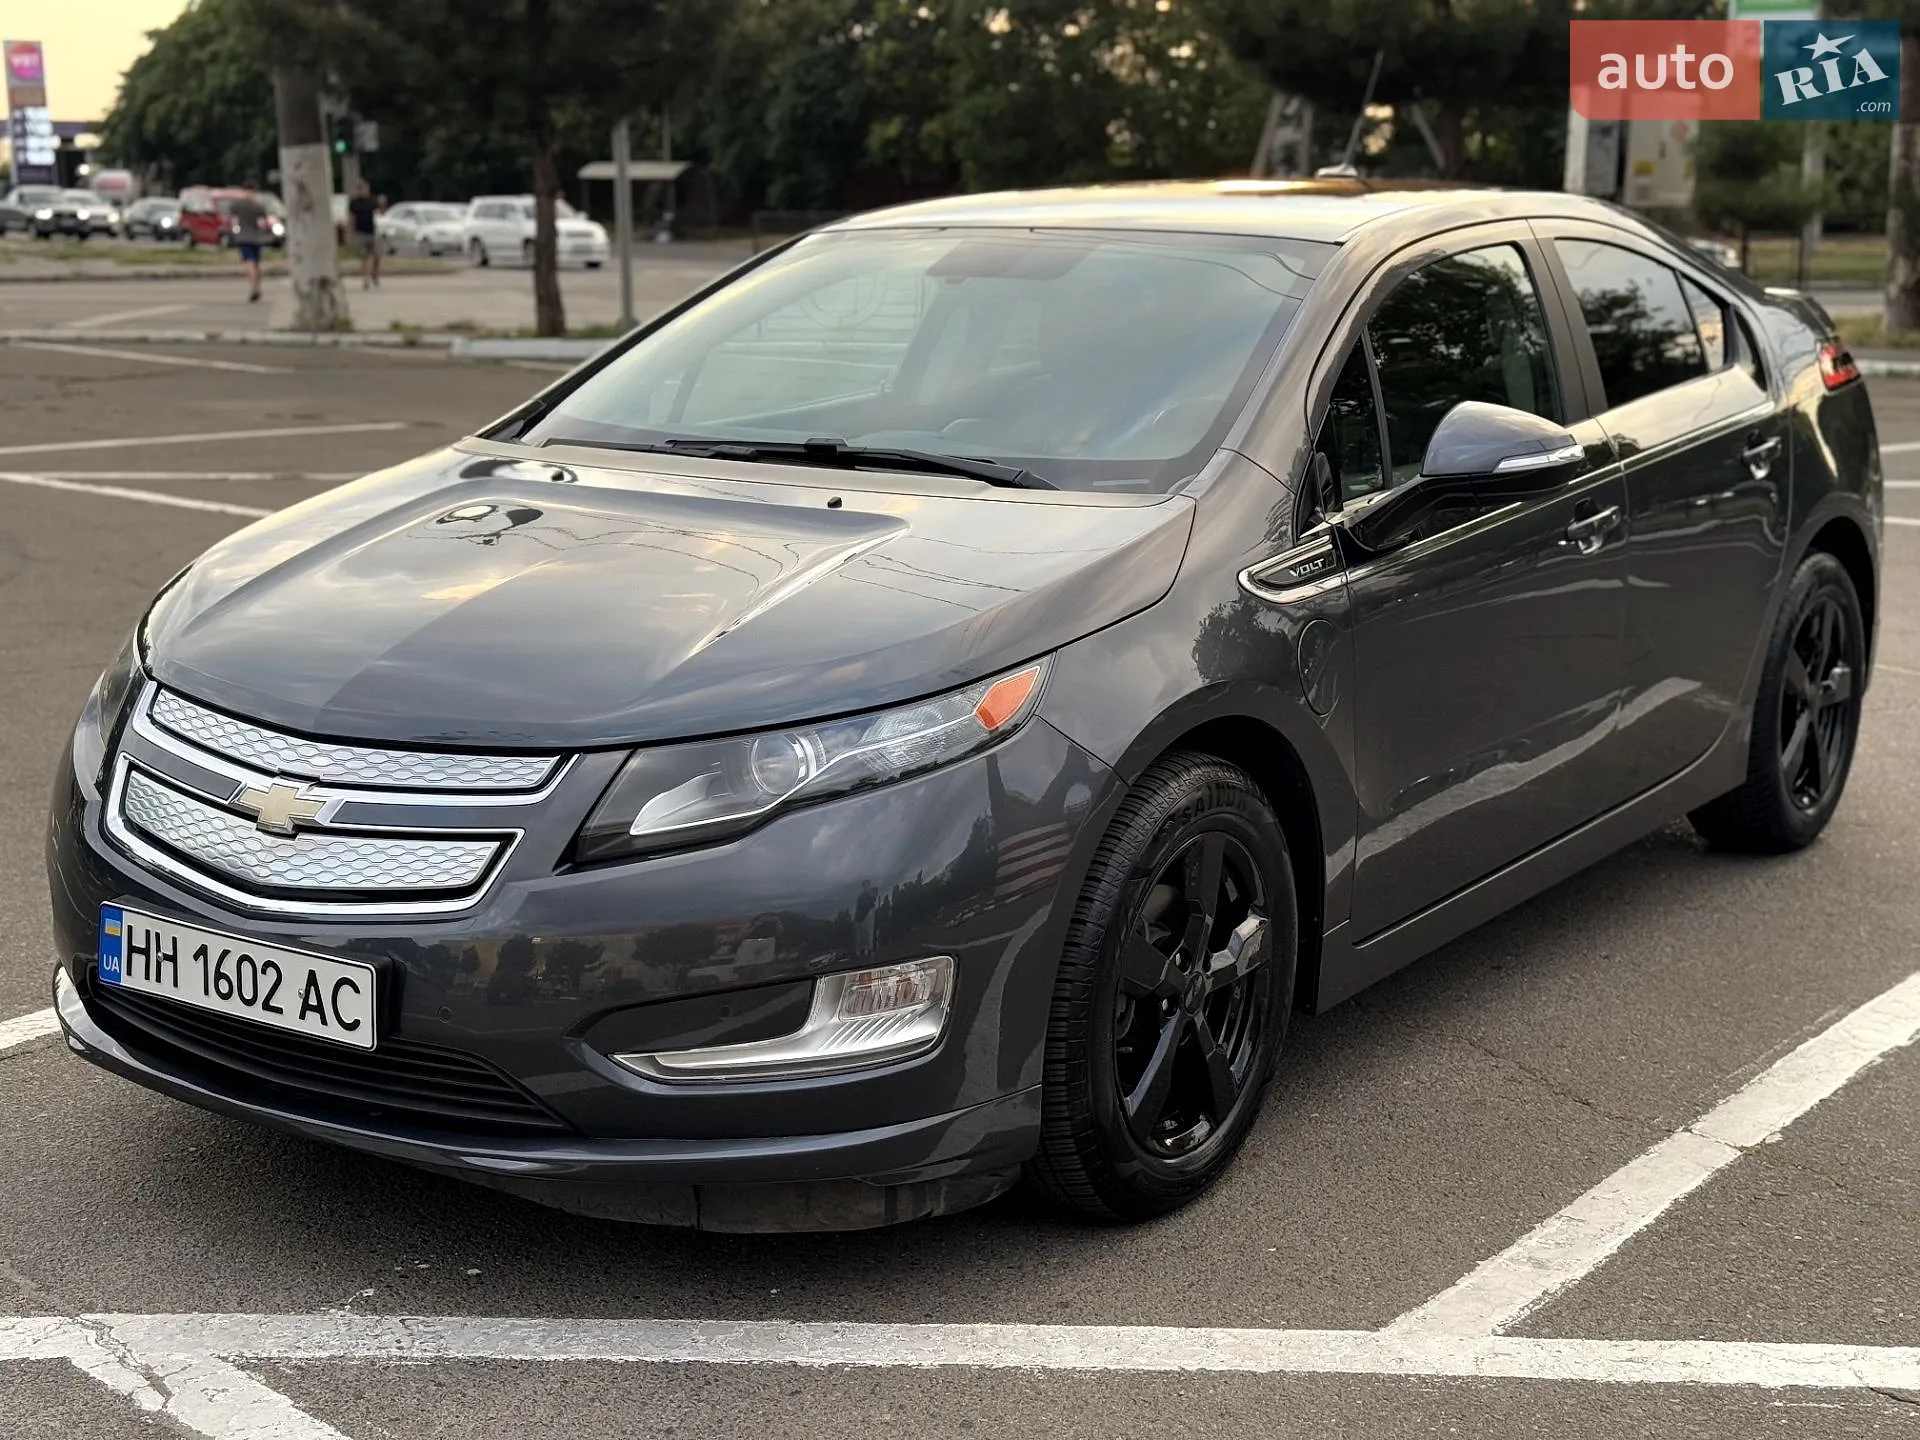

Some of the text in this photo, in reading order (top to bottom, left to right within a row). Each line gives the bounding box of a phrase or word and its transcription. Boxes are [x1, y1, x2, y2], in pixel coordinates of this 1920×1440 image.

[1289, 558, 1325, 577] VOLT
[103, 953, 120, 973] UA
[126, 924, 361, 1031] HH 1602 AC
